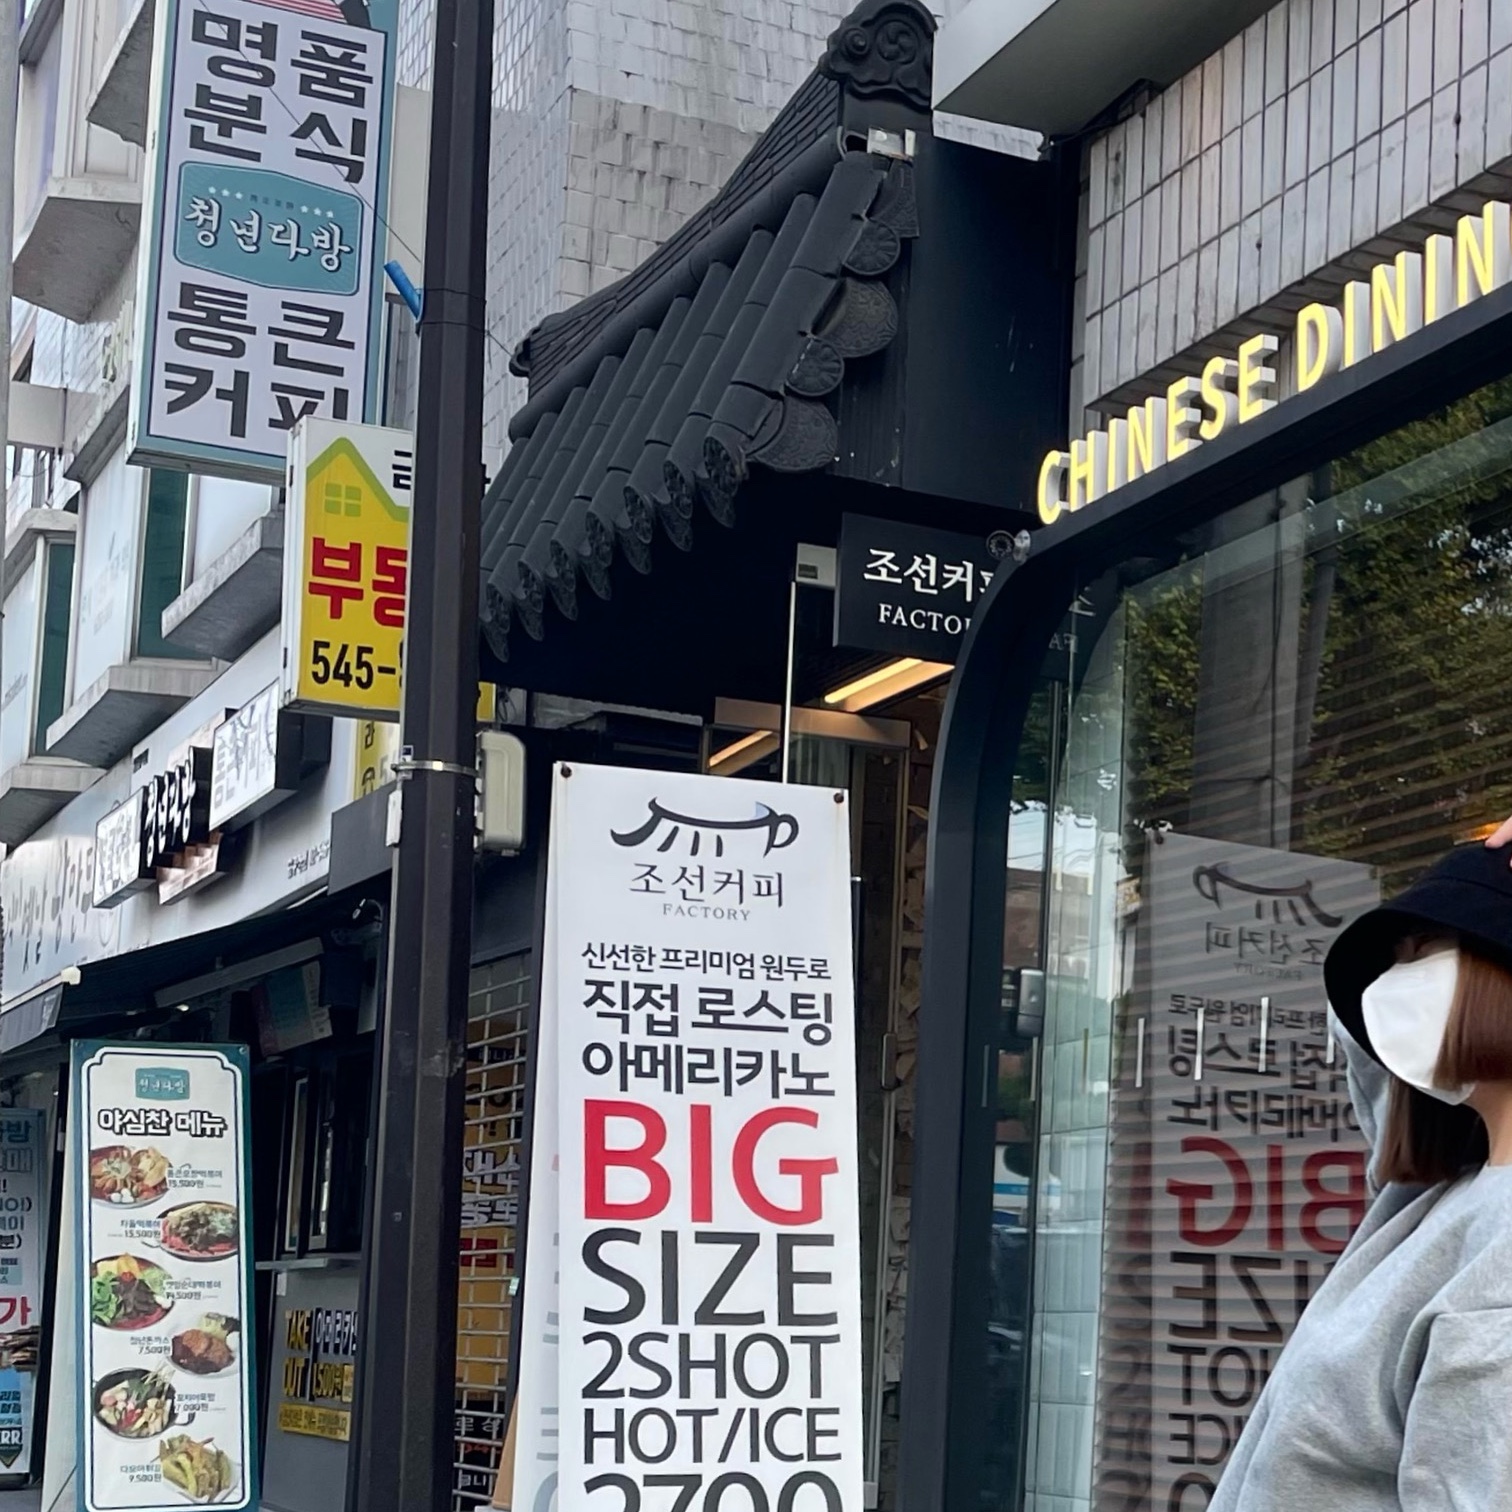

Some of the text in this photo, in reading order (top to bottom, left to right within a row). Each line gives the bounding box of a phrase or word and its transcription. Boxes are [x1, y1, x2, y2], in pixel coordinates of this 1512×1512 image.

[191, 9, 373, 109] 명품
[184, 83, 367, 184] 분식
[184, 196, 354, 272] 청년다방
[167, 282, 355, 377] 통큰
[165, 362, 349, 438] 커피
[1037, 334, 1280, 526] CHINESE
[311, 640, 404, 690] 545-
[629, 863, 783, 908] 조선커피
[662, 903, 751, 922] FACTORY
[581, 942, 832, 982] 신선한 프리미엄 원두로
[583, 979, 832, 1047] 직접 로스팅
[581, 1041, 836, 1099] 아메리카노
[98, 1107, 228, 1139] 야심찬 메뉴
[583, 1098, 839, 1226] BIG
[581, 1227, 838, 1327] SIZE
[581, 1332, 841, 1400] 2SHOT
[583, 1406, 843, 1465] HOT/ICE
